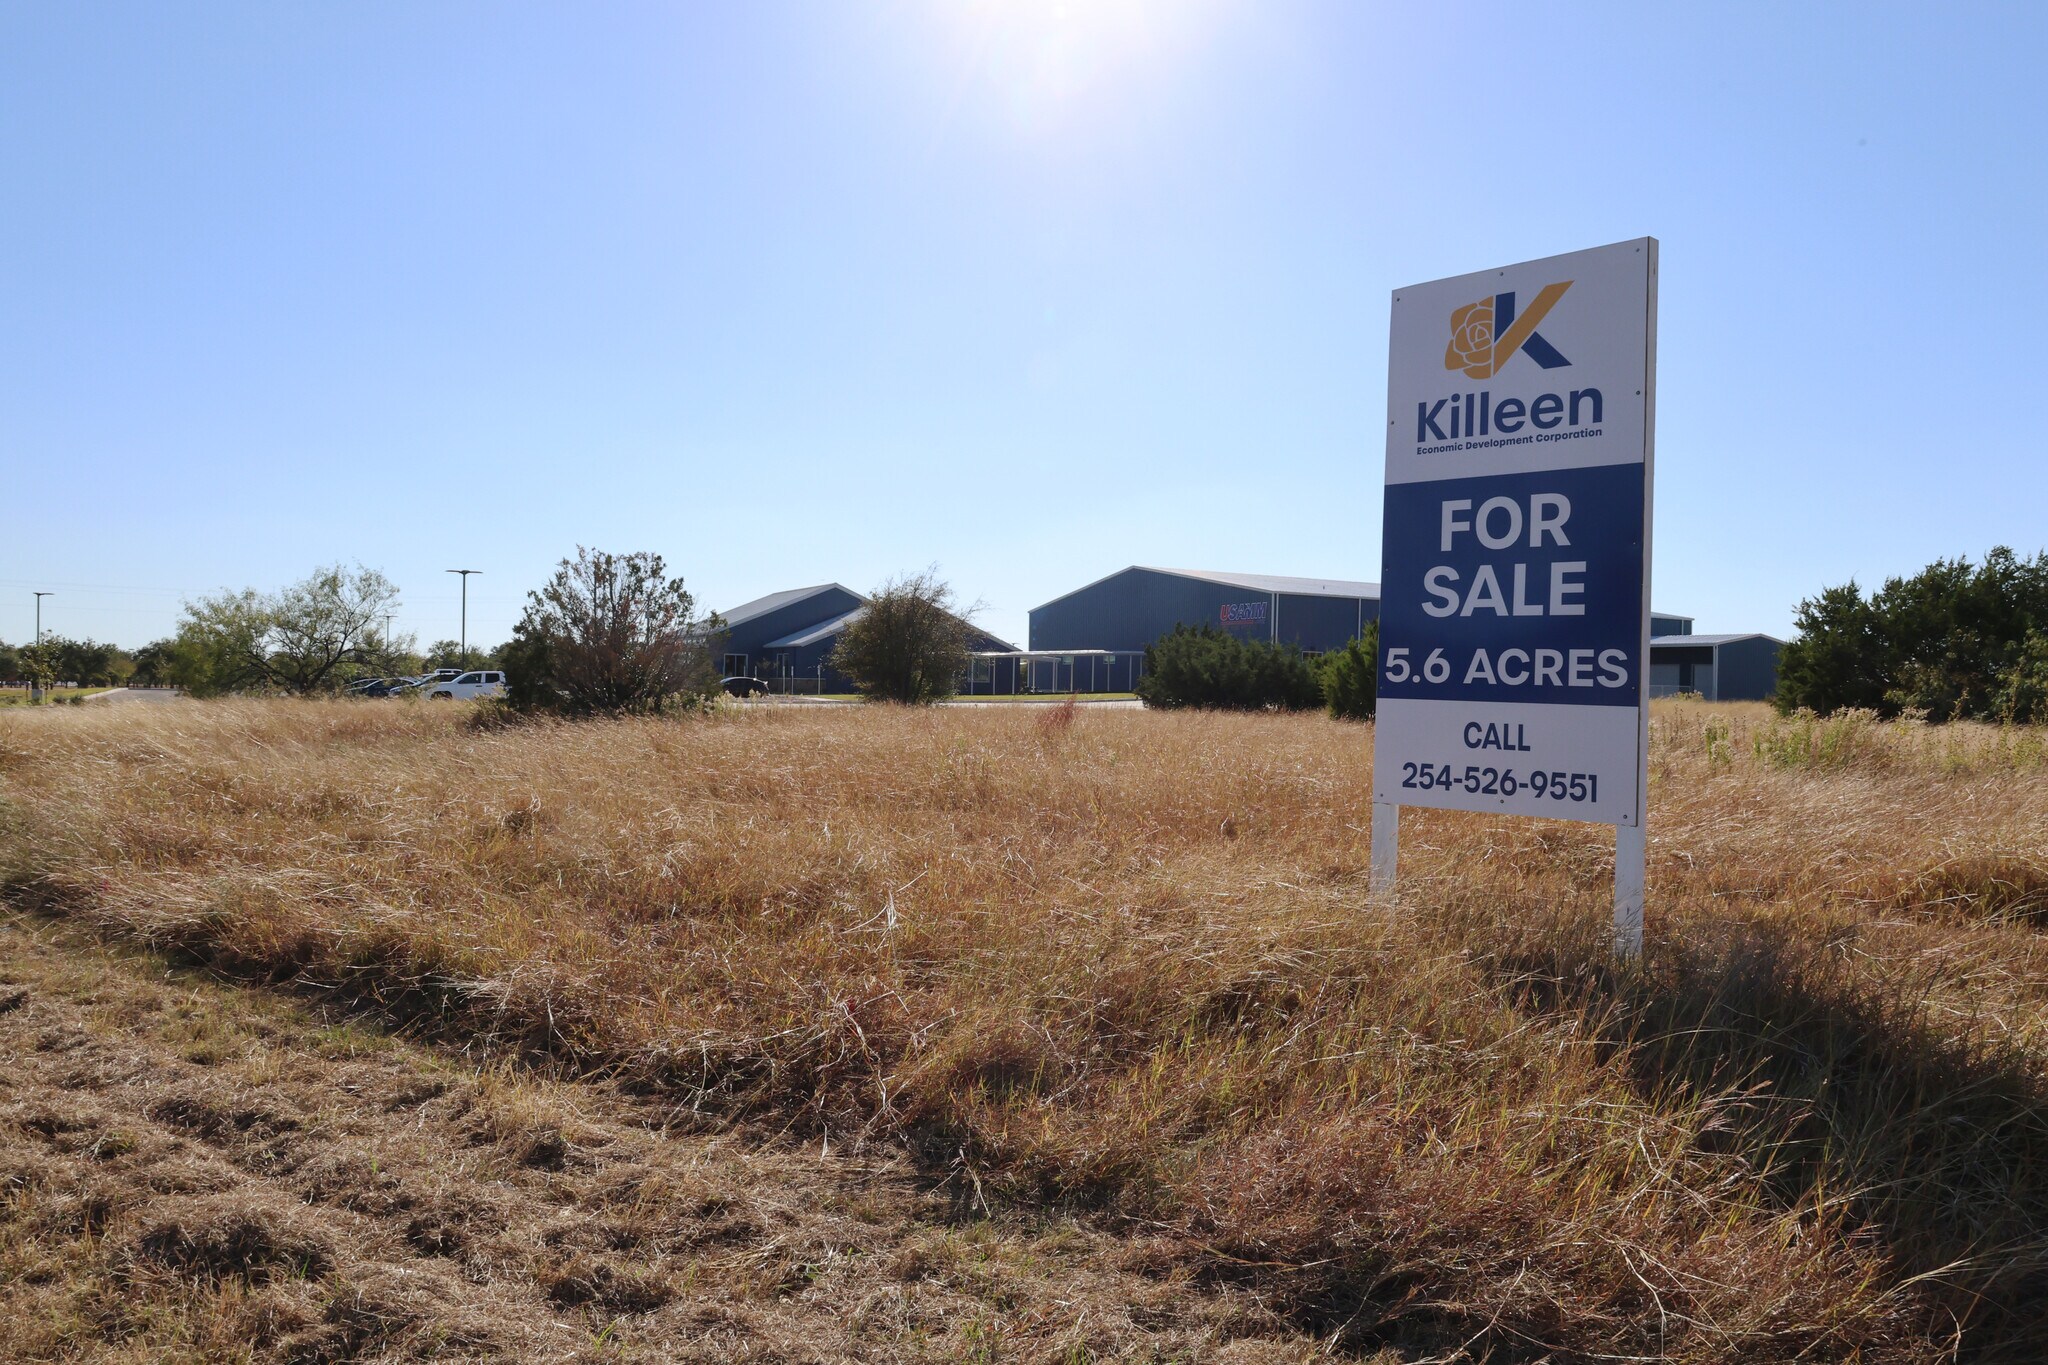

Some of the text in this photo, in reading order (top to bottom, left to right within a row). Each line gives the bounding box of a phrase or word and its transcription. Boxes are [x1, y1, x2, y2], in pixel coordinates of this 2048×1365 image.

[1417, 387, 1603, 443] Killeen
[1416, 428, 1602, 455] Economic Development Corporation
[1441, 494, 1571, 552] FOR
[1421, 561, 1587, 618] SALE
[1385, 648, 1629, 688] 5.6 ACRES
[1463, 721, 1531, 752] CALL
[1402, 762, 1597, 803] 254-526-9551
